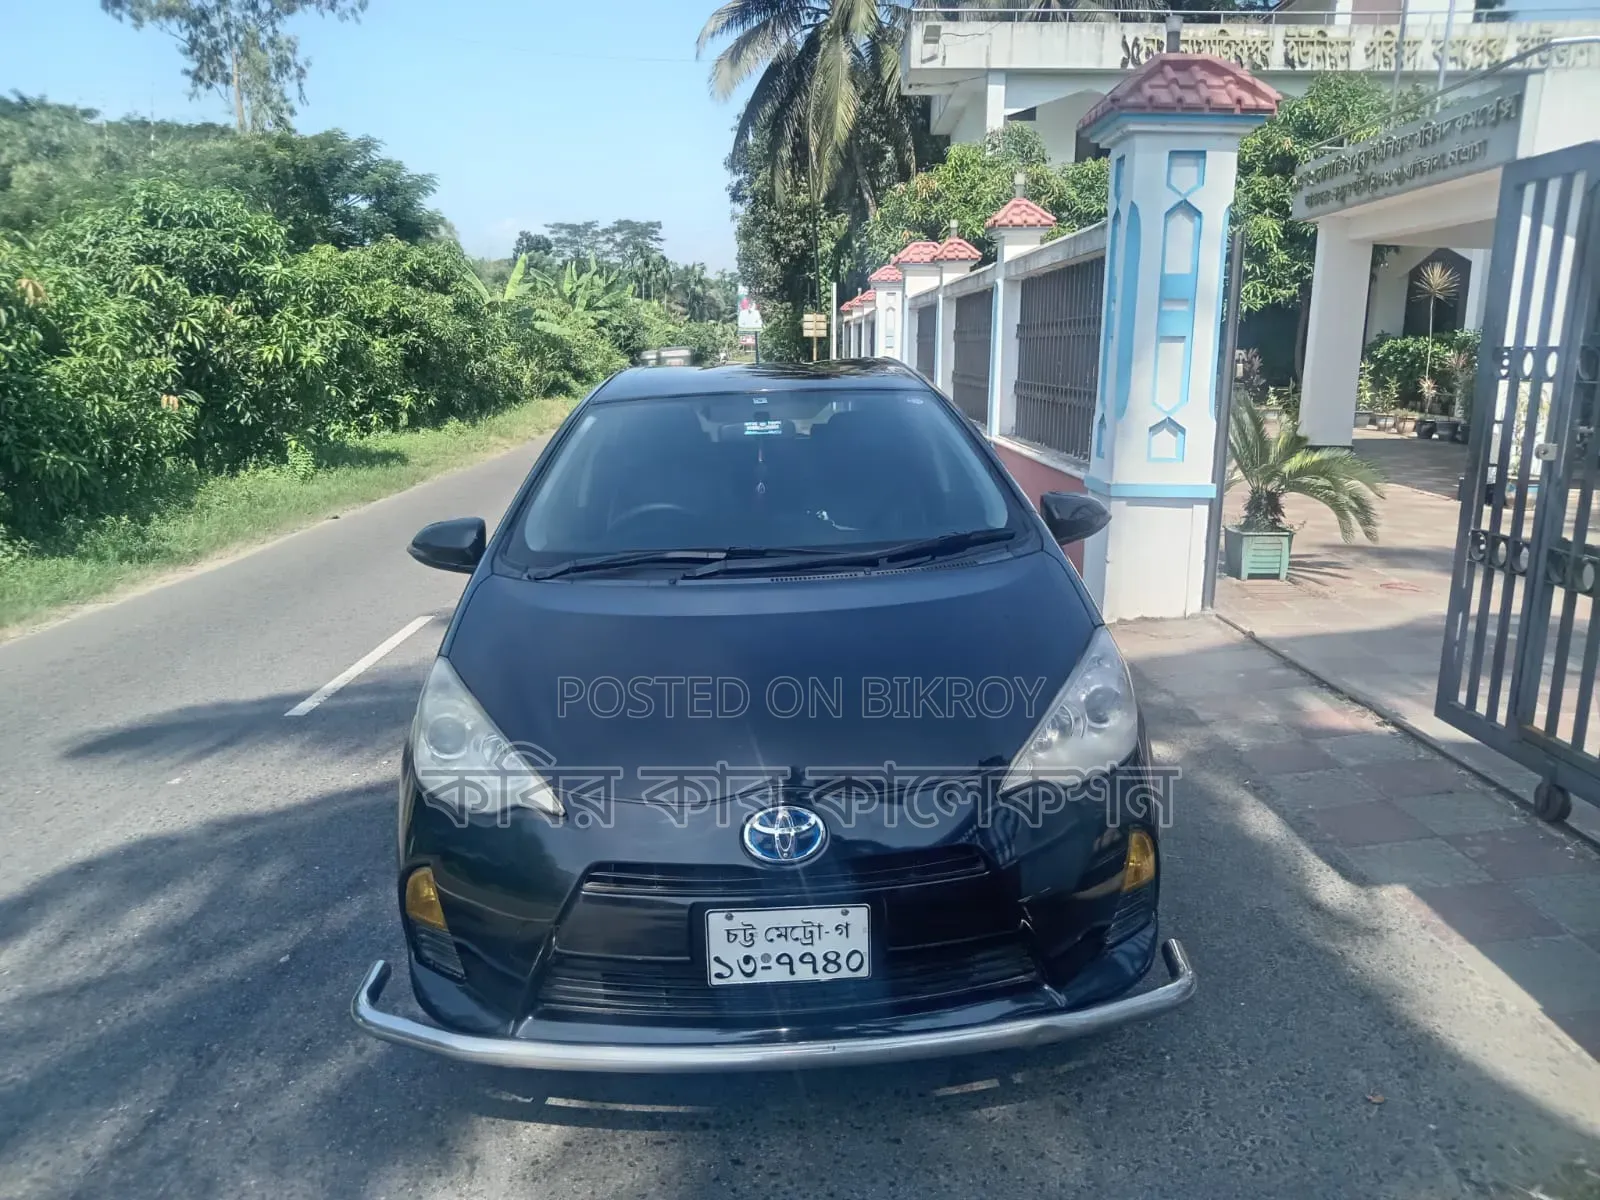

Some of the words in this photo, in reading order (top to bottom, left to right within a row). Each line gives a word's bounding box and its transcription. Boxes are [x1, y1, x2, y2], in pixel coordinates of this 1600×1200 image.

[724, 921, 757, 948] চট্ট
[764, 918, 851, 947] মেট্রো-গ
[712, 949, 865, 980] ১৩-৭৭৪০
